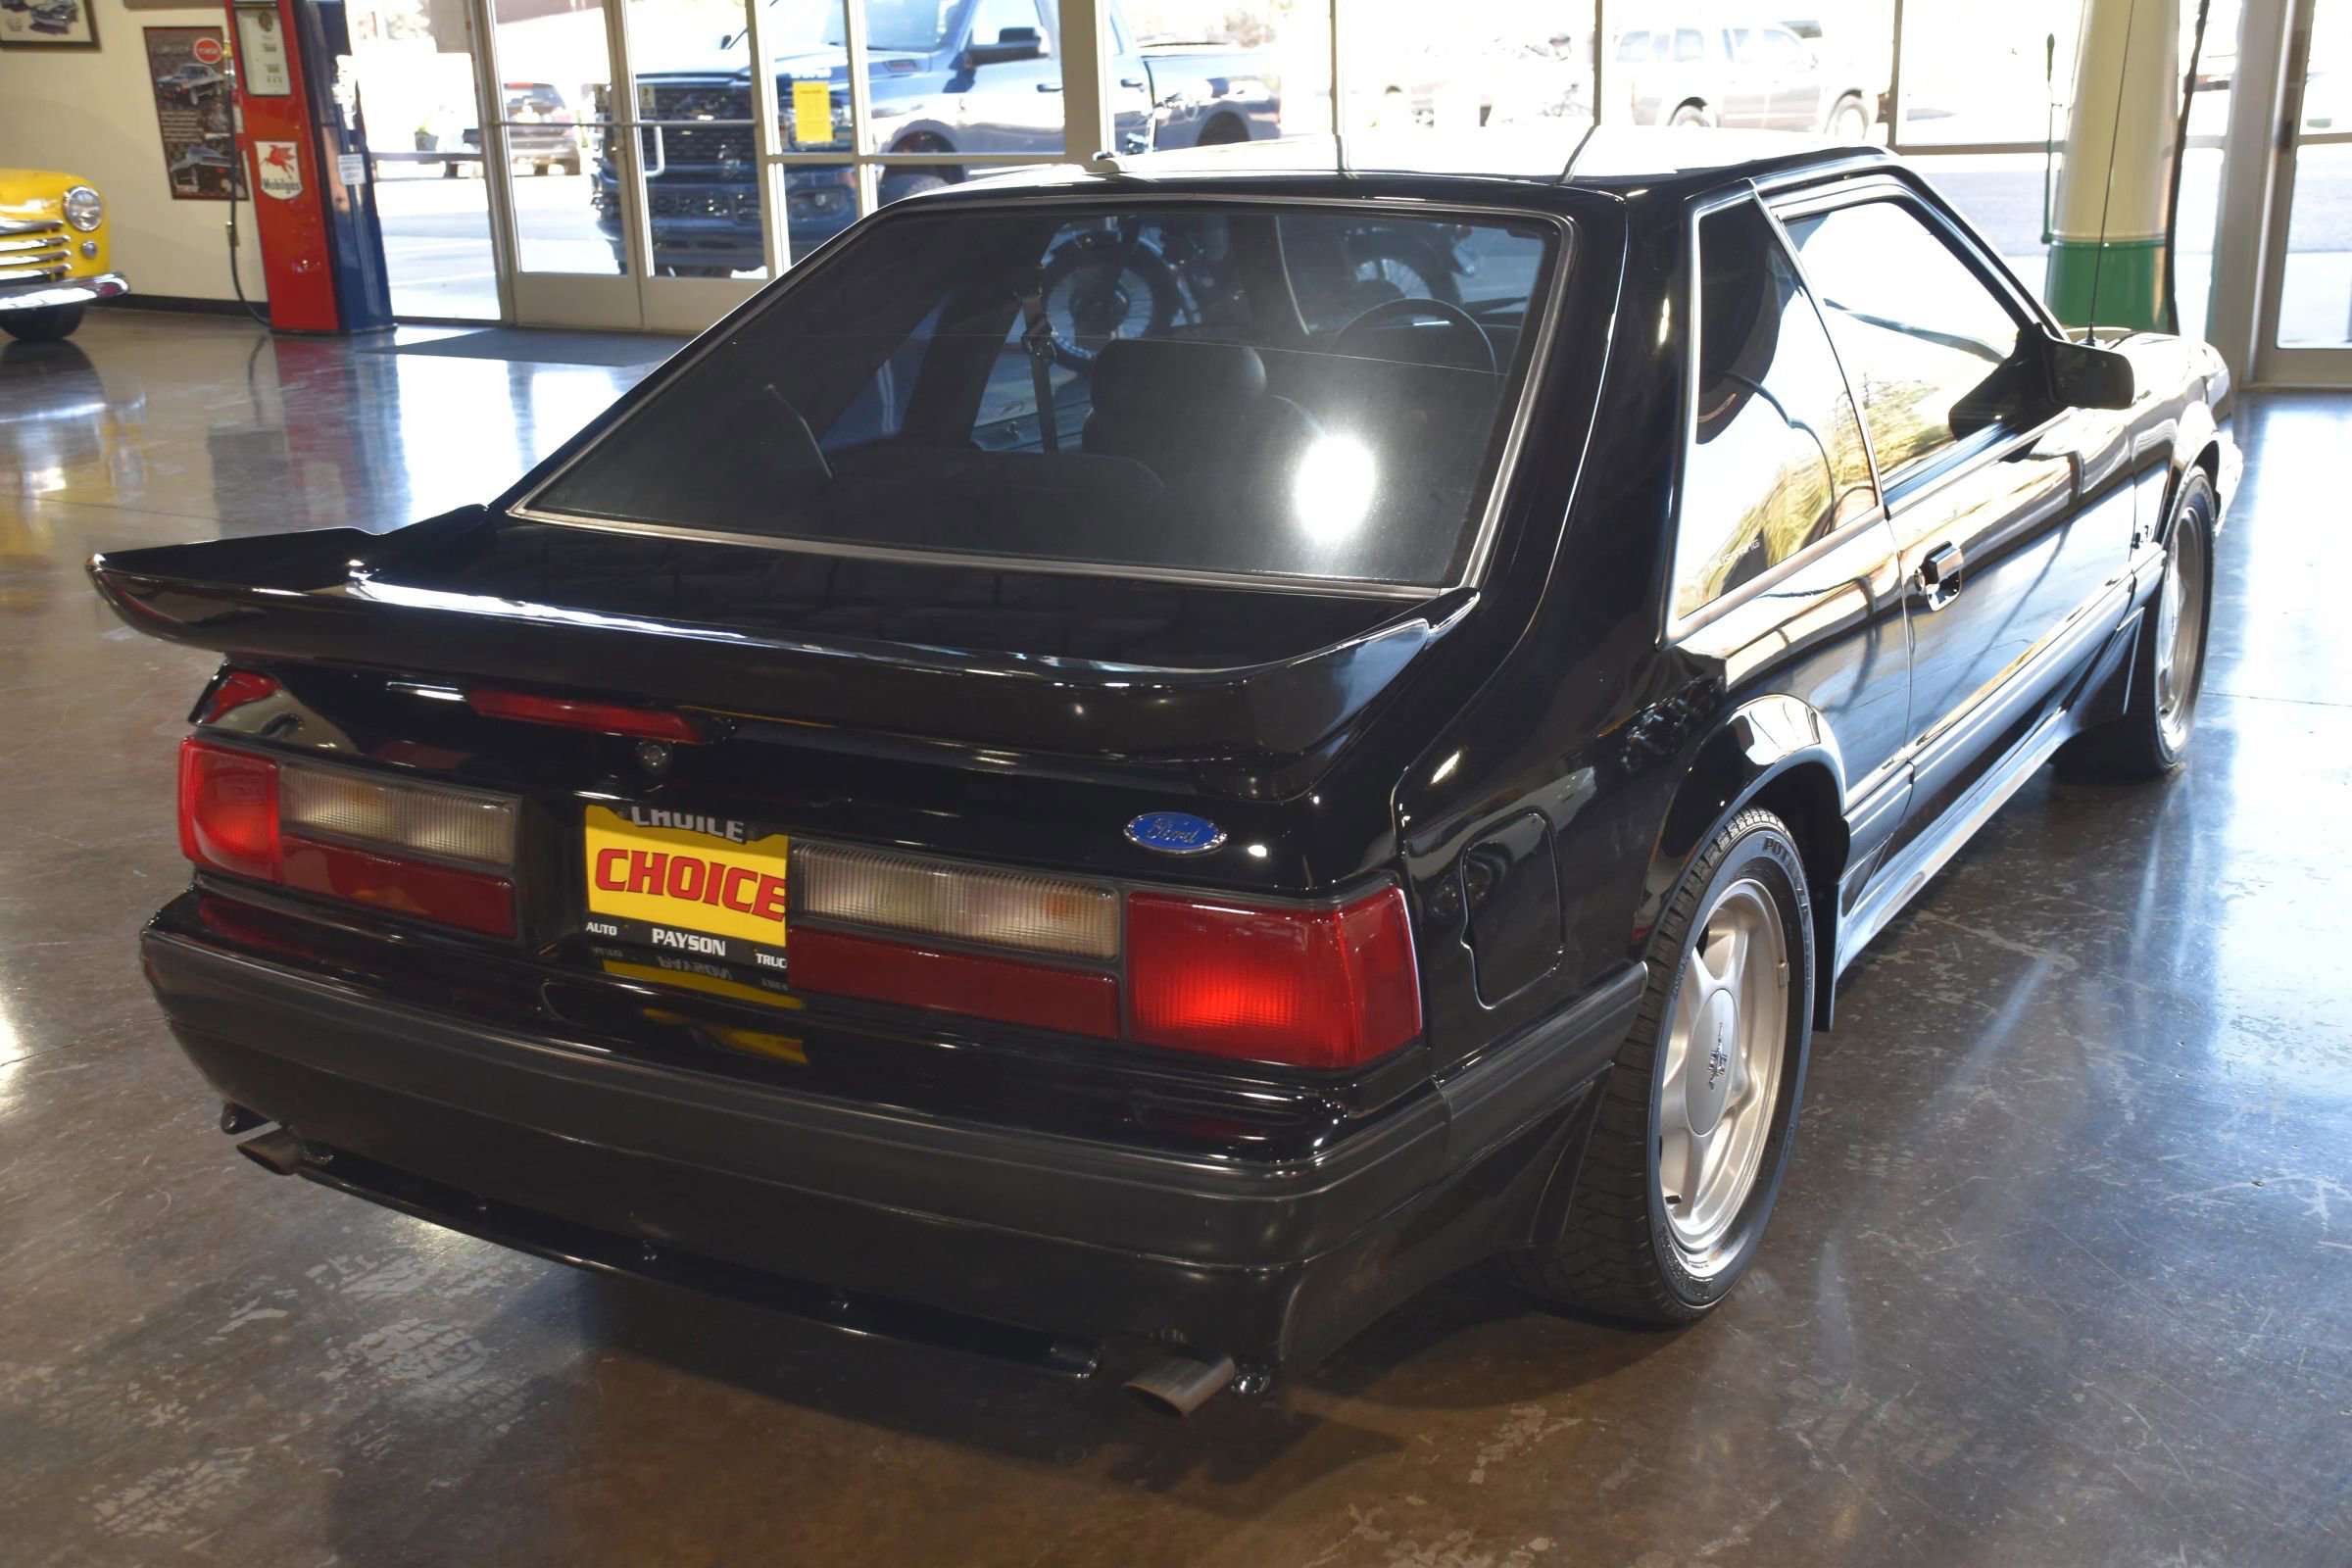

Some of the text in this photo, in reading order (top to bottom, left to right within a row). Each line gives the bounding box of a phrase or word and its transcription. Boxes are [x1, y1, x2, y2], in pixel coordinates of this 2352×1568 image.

[1147, 816, 1201, 844] Ford
[595, 848, 786, 922] CHOICE
[585, 921, 788, 969] AUTO PAYSON TRUC
